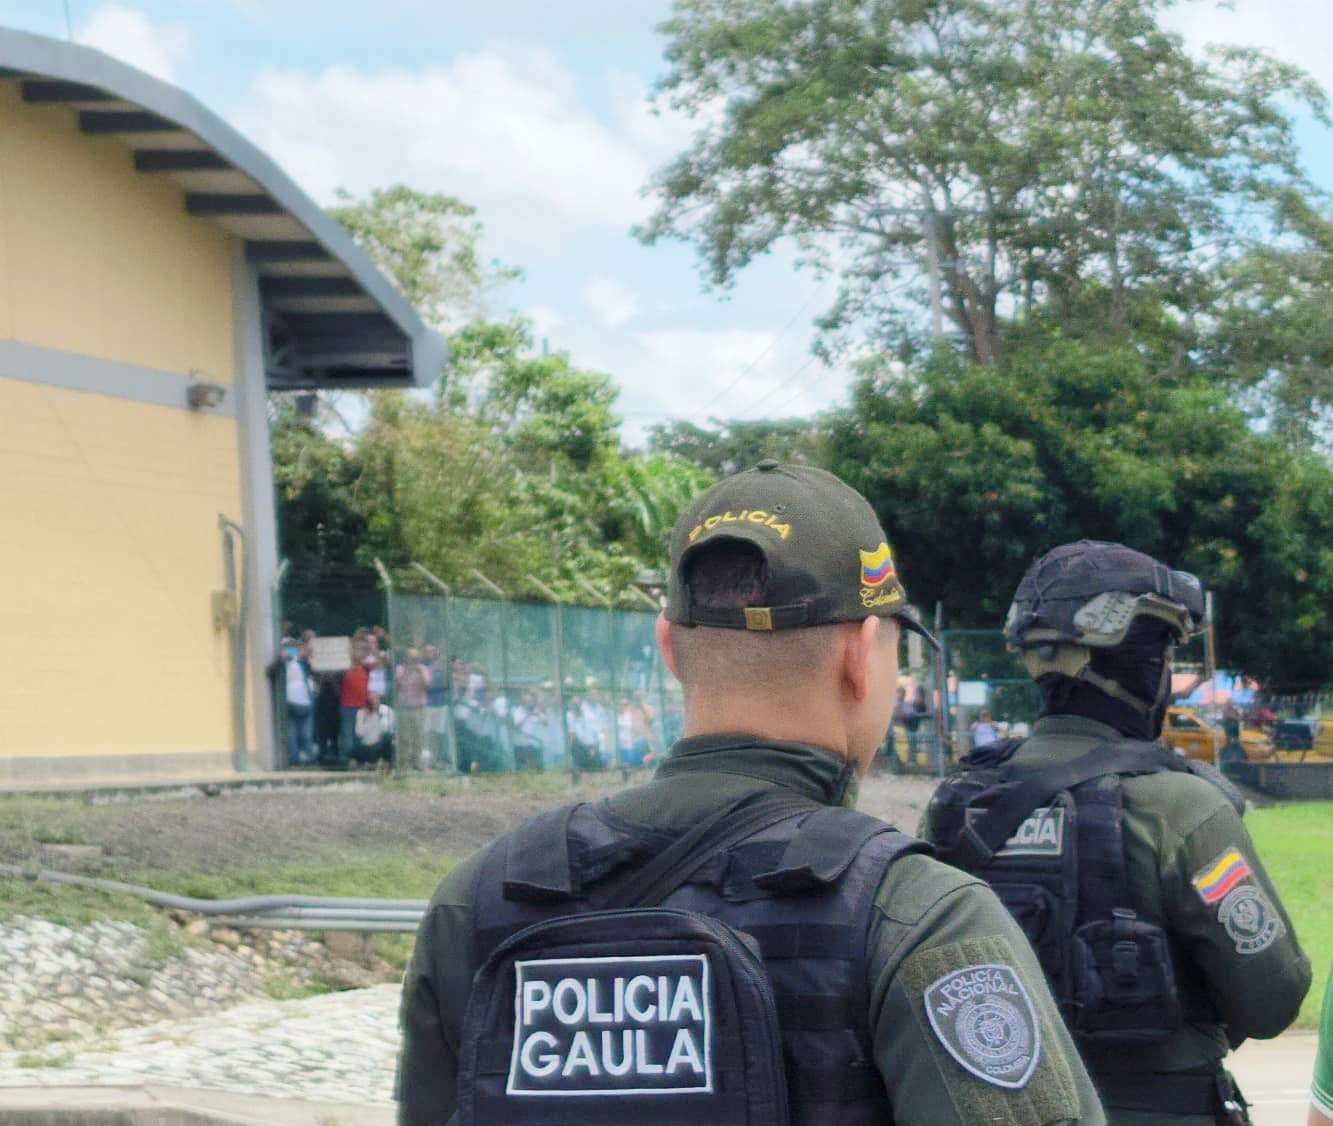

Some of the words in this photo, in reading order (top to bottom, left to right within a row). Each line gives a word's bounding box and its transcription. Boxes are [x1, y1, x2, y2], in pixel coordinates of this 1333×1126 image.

[688, 510, 792, 542] POLICIA
[523, 975, 703, 1025] POLICIA
[936, 981, 1019, 1016] NACIONAL
[520, 1028, 705, 1078] GAULA
